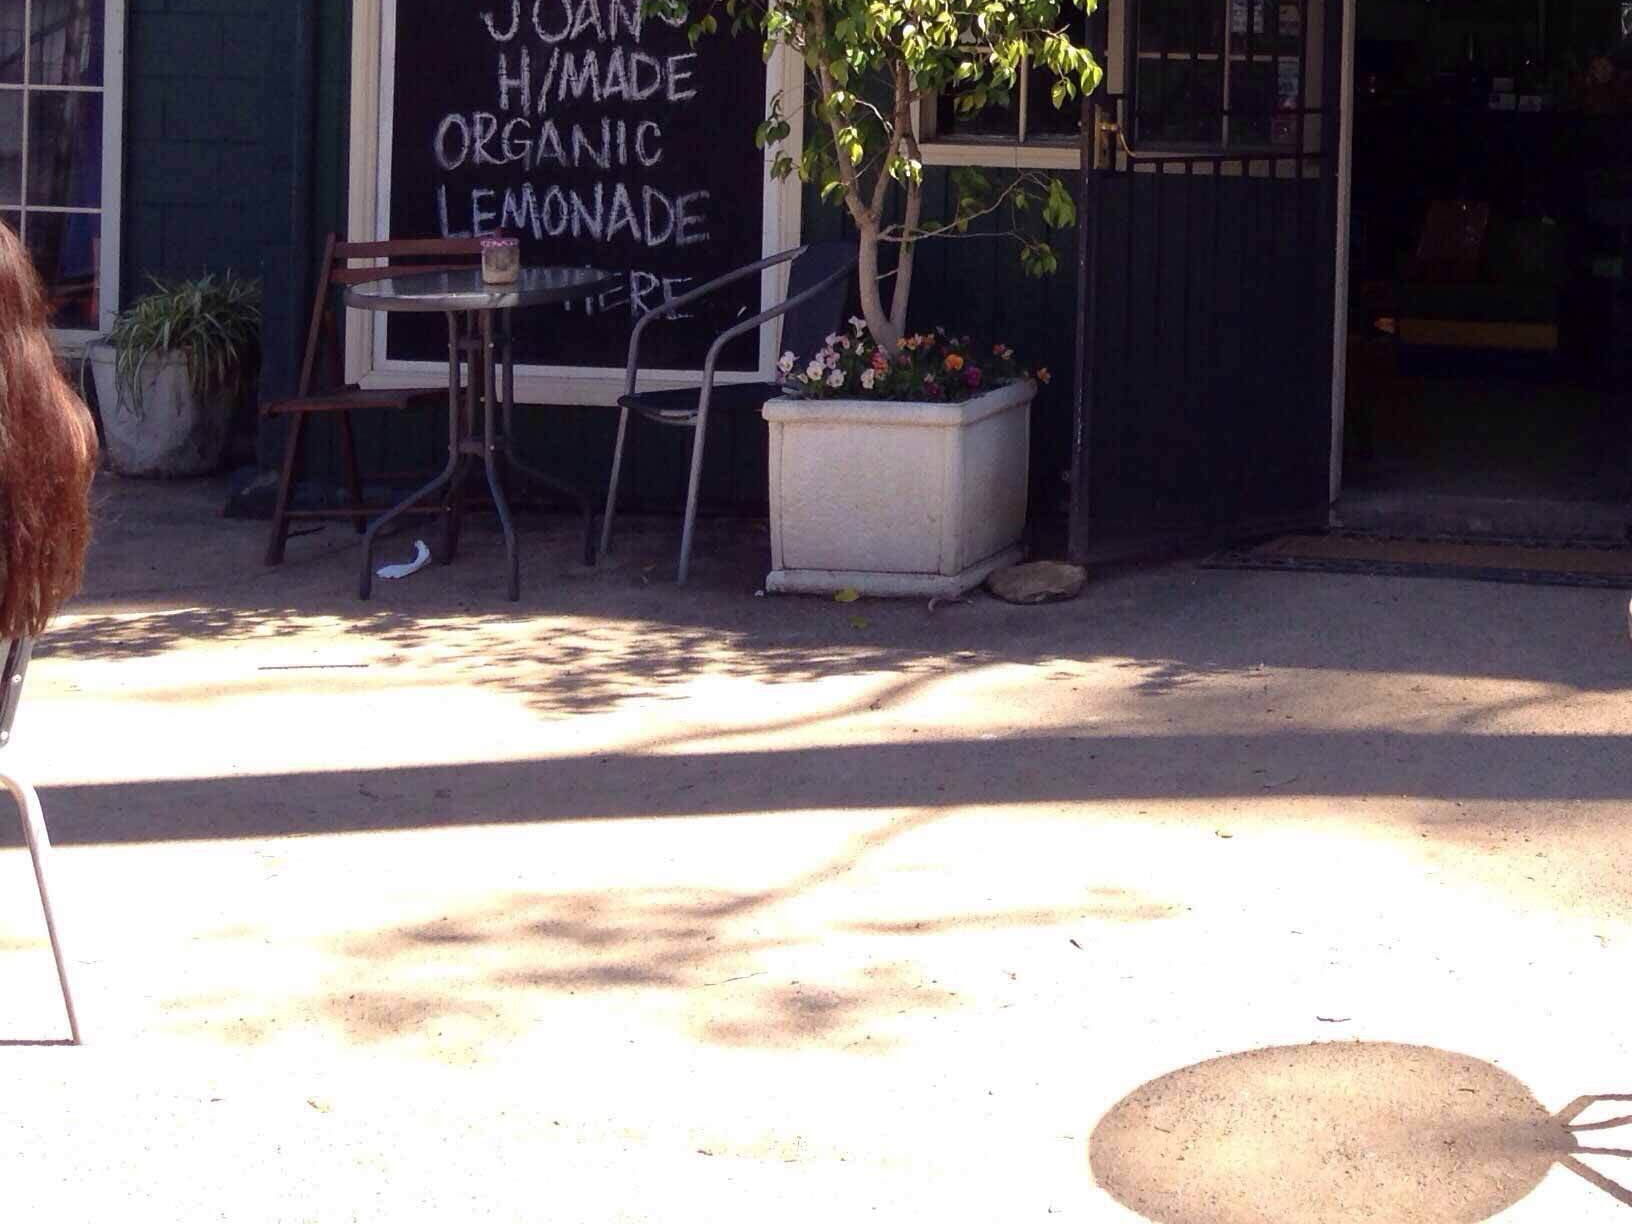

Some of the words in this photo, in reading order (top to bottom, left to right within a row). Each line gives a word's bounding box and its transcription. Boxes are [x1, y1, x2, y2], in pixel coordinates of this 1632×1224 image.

[498, 45, 697, 115] H/MADE
[434, 112, 663, 172] ORGANIC
[437, 182, 710, 247] LEMONADE
